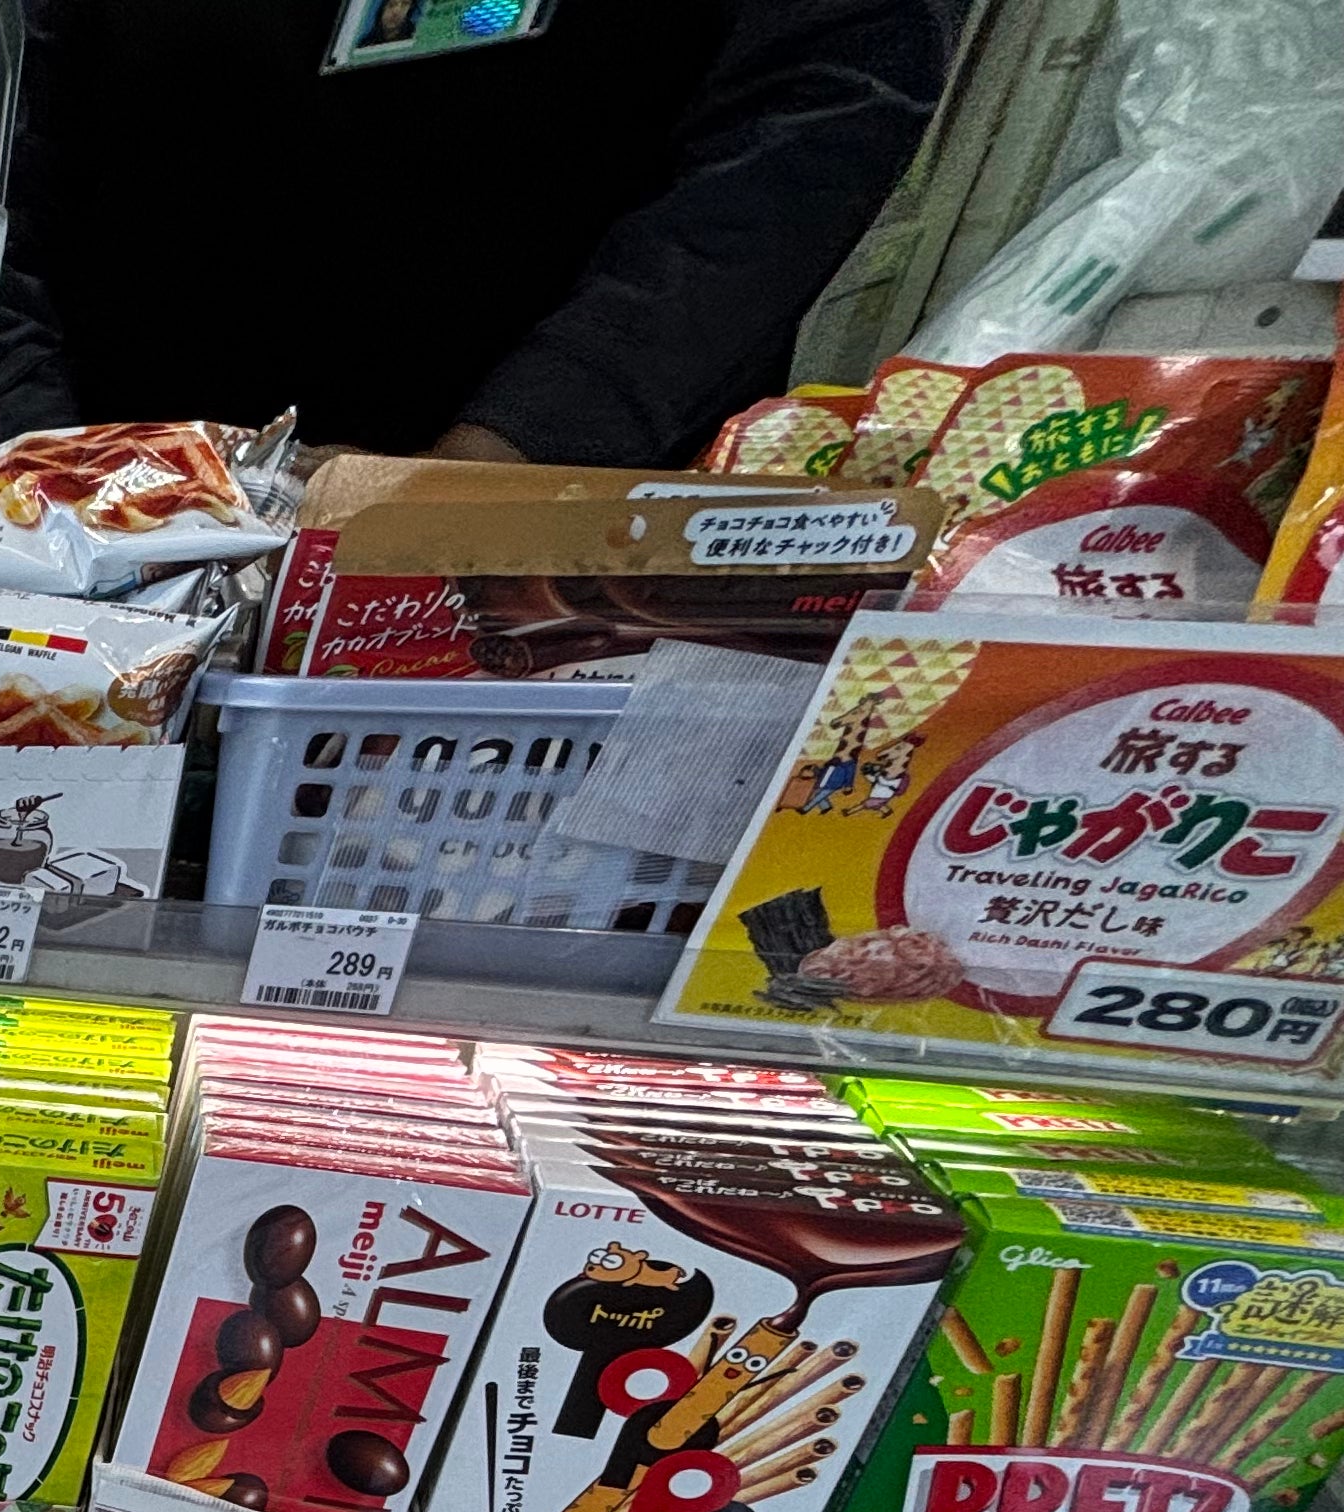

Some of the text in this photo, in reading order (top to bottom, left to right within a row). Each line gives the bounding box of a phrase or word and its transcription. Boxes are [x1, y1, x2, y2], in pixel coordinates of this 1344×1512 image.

[1028, 405, 1122, 454] 旅する
[698, 508, 875, 535] チョコチョコ食べやすい
[705, 532, 902, 557] 便利なチャック付き!
[1080, 523, 1166, 554] Calbee
[1052, 564, 1184, 599] 旅する
[334, 588, 466, 627] こだわりの
[320, 615, 479, 661] カカオブレンド
[27, 649, 58, 661] WAFFLE
[369, 649, 459, 678] Cacao
[1149, 700, 1251, 727] Calbee
[1098, 730, 1247, 776] 旅する
[940, 784, 1327, 880] じゃがりこ
[945, 864, 1249, 906] Traveling JagaRico
[982, 898, 1164, 935] 贅沢だし味
[968, 931, 1145, 957] Rich Dashi Flavor
[326, 951, 393, 980] 289円
[554, 1201, 647, 1225] LOTTE
[588, 1303, 666, 1331] トッポ
[20, 1343, 57, 1444] 明治チョコスナック
